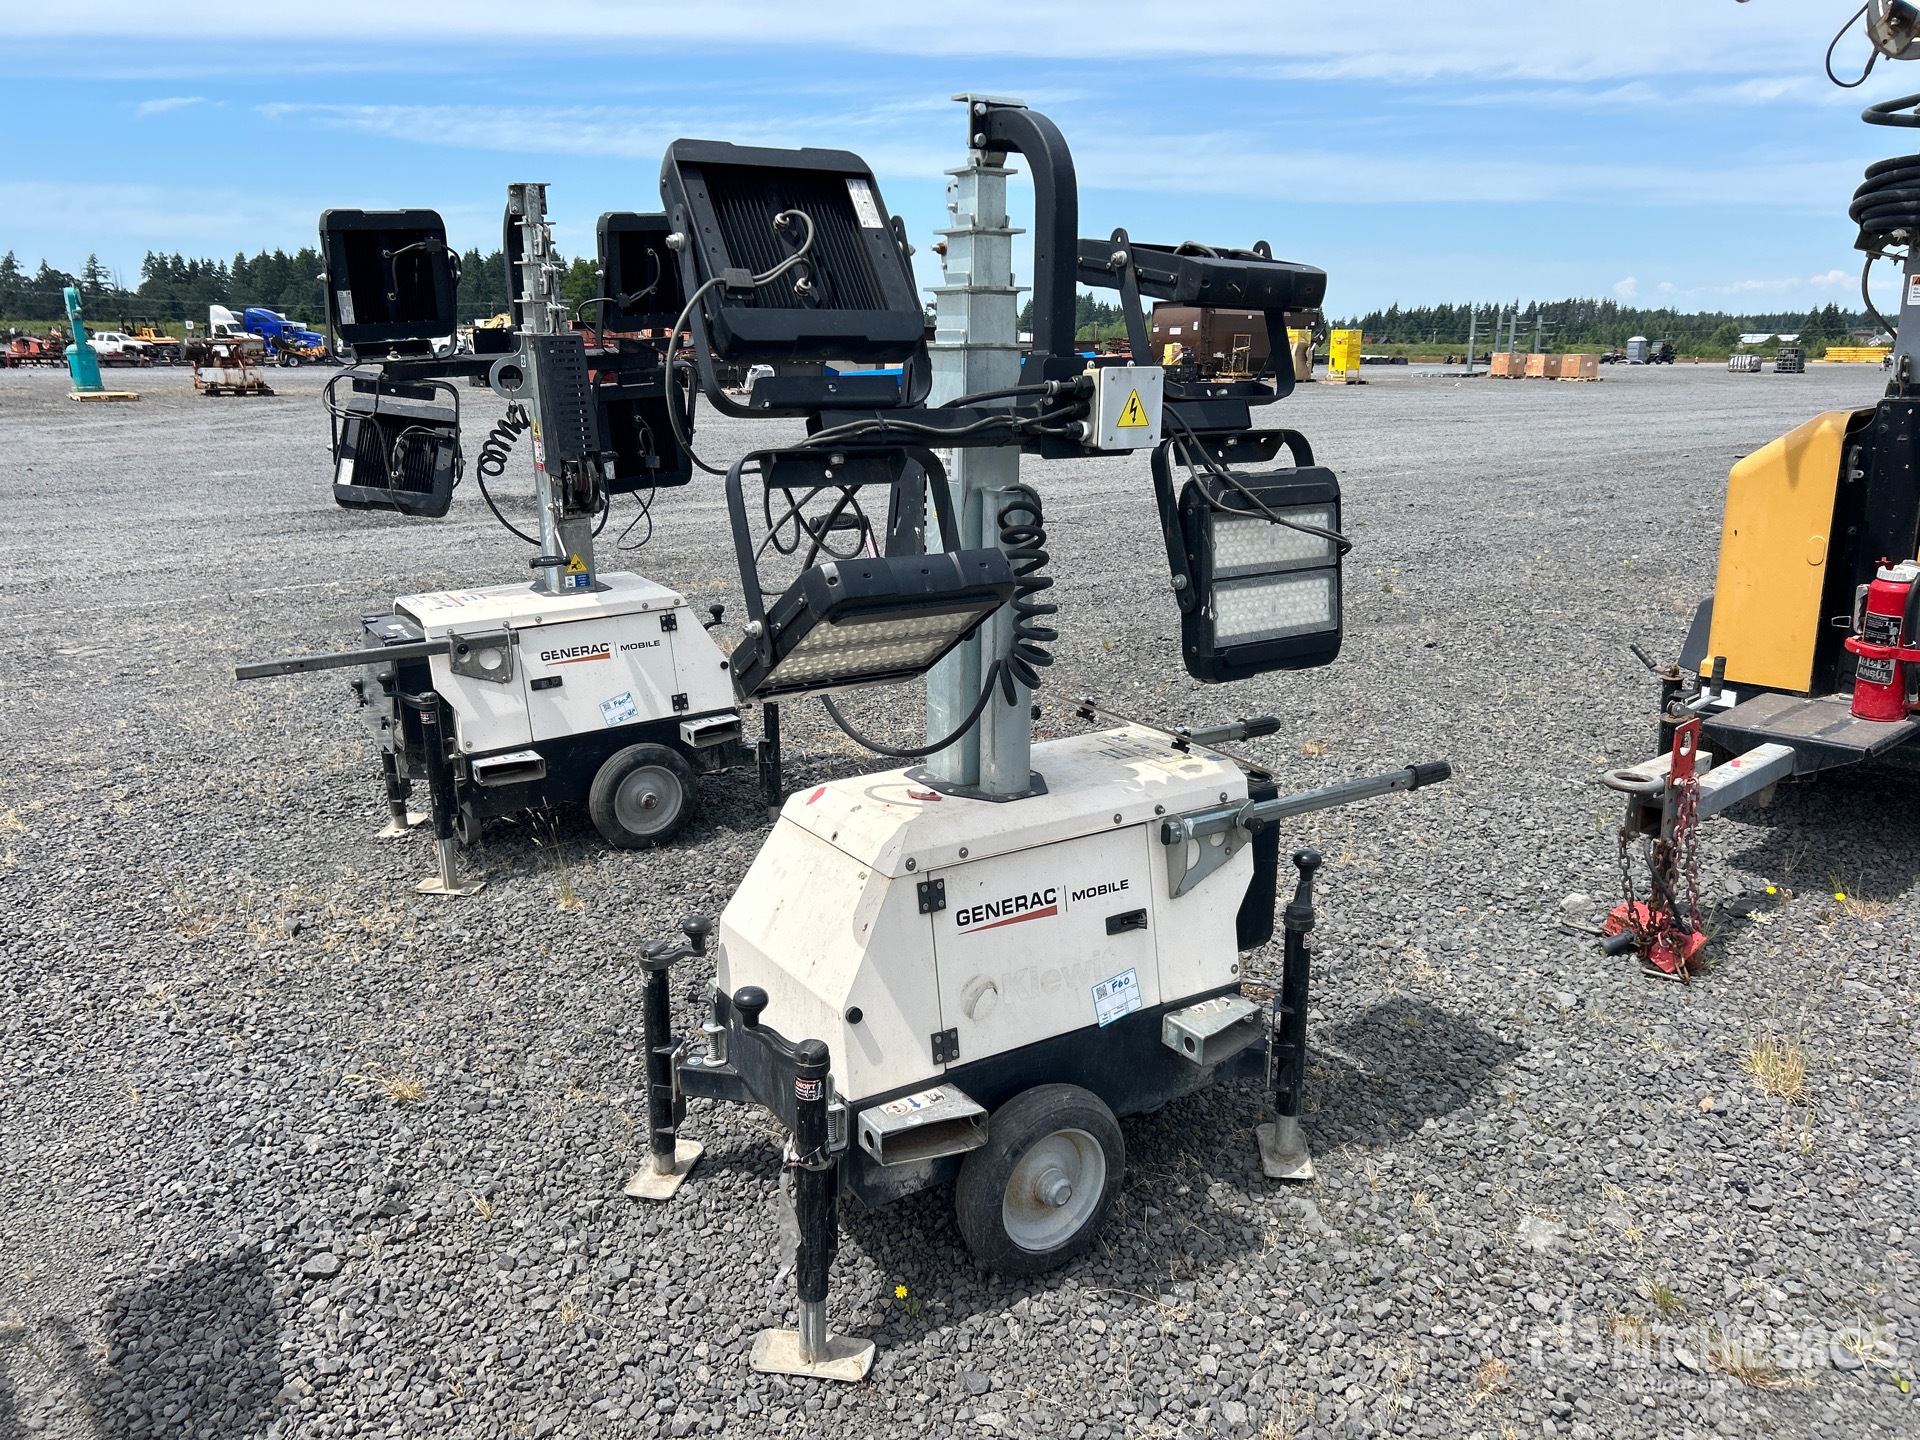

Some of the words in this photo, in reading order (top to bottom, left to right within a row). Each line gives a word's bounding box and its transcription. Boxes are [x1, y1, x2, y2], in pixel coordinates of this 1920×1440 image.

[540, 642, 610, 662] GENERAC
[620, 640, 660, 652] MOBILE
[1859, 666, 1889, 680] ANSUL
[956, 887, 1058, 927] GENERAC
[1071, 879, 1130, 902] MOBILE
